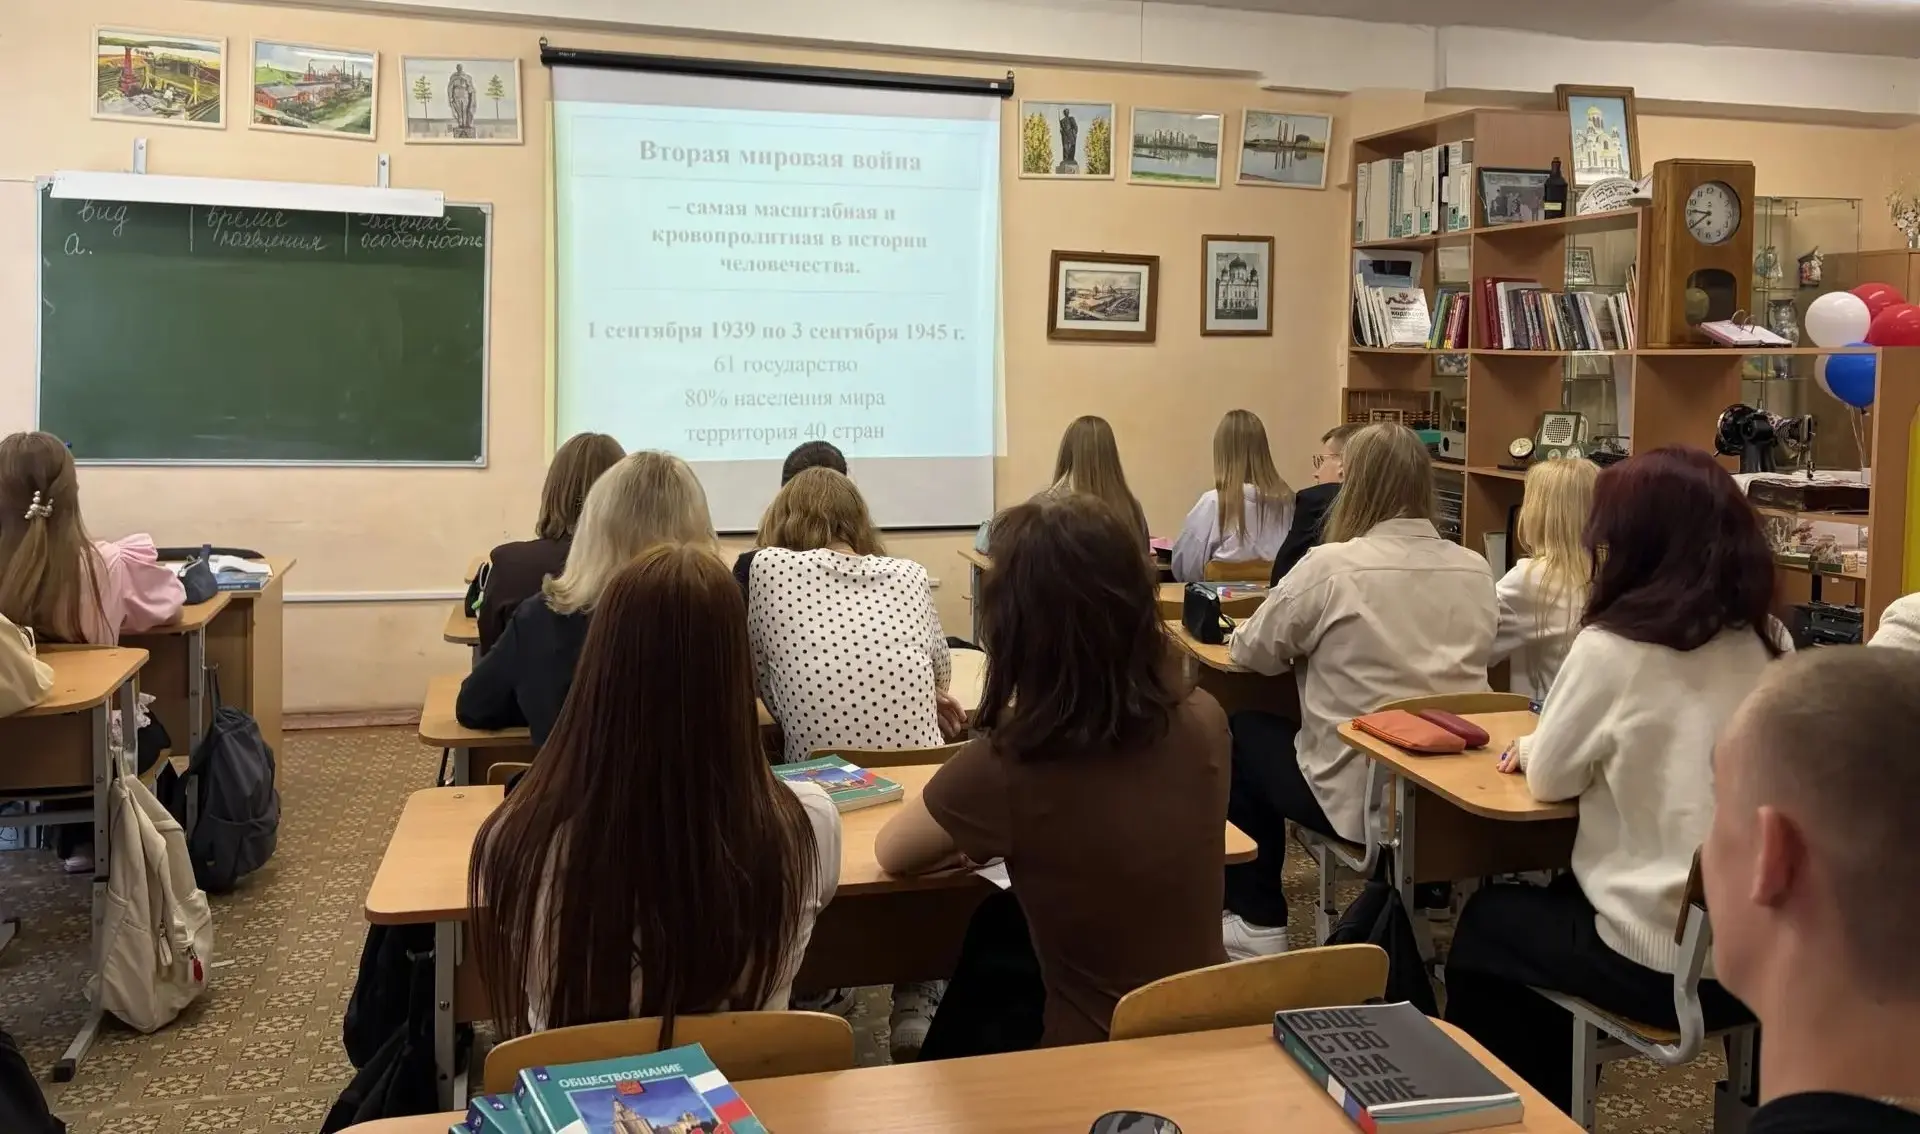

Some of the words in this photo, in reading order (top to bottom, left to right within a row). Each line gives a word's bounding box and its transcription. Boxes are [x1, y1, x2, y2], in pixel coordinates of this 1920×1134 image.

[641, 140, 729, 167] Вторая
[740, 150, 843, 171] мировая
[853, 150, 921, 170] война
[686, 203, 746, 216] самая
[755, 202, 877, 219] масштабная
[884, 209, 895, 220] и
[361, 230, 483, 249] особенность
[653, 230, 823, 248] кровопролитная
[831, 235, 842, 246] в
[849, 235, 926, 251] истории
[721, 259, 860, 274] человечества.
[589, 322, 595, 338] 1
[605, 321, 702, 343] сентября
[713, 321, 755, 339] 1939
[763, 327, 786, 339] по
[792, 322, 802, 339] 3
[809, 323, 898, 344] сентября
[908, 324, 947, 340] 1945
[954, 329, 964, 340] г.
[714, 355, 733, 372] 61
[744, 360, 857, 377] государство
[685, 389, 727, 407] 80%
[735, 393, 832, 406] населения
[840, 393, 885, 410] мира
[685, 427, 797, 446] территория
[804, 423, 826, 442] 40
[833, 426, 883, 443] стран
[1287, 1009, 1377, 1032] ОБЩЕ
[1307, 1030, 1390, 1054] СТВО
[558, 1063, 684, 1088] ОБЩЕСТВОЗНАНИЕ
[1329, 1053, 1403, 1078] ЗНА
[1351, 1076, 1428, 1104] НИЕ
